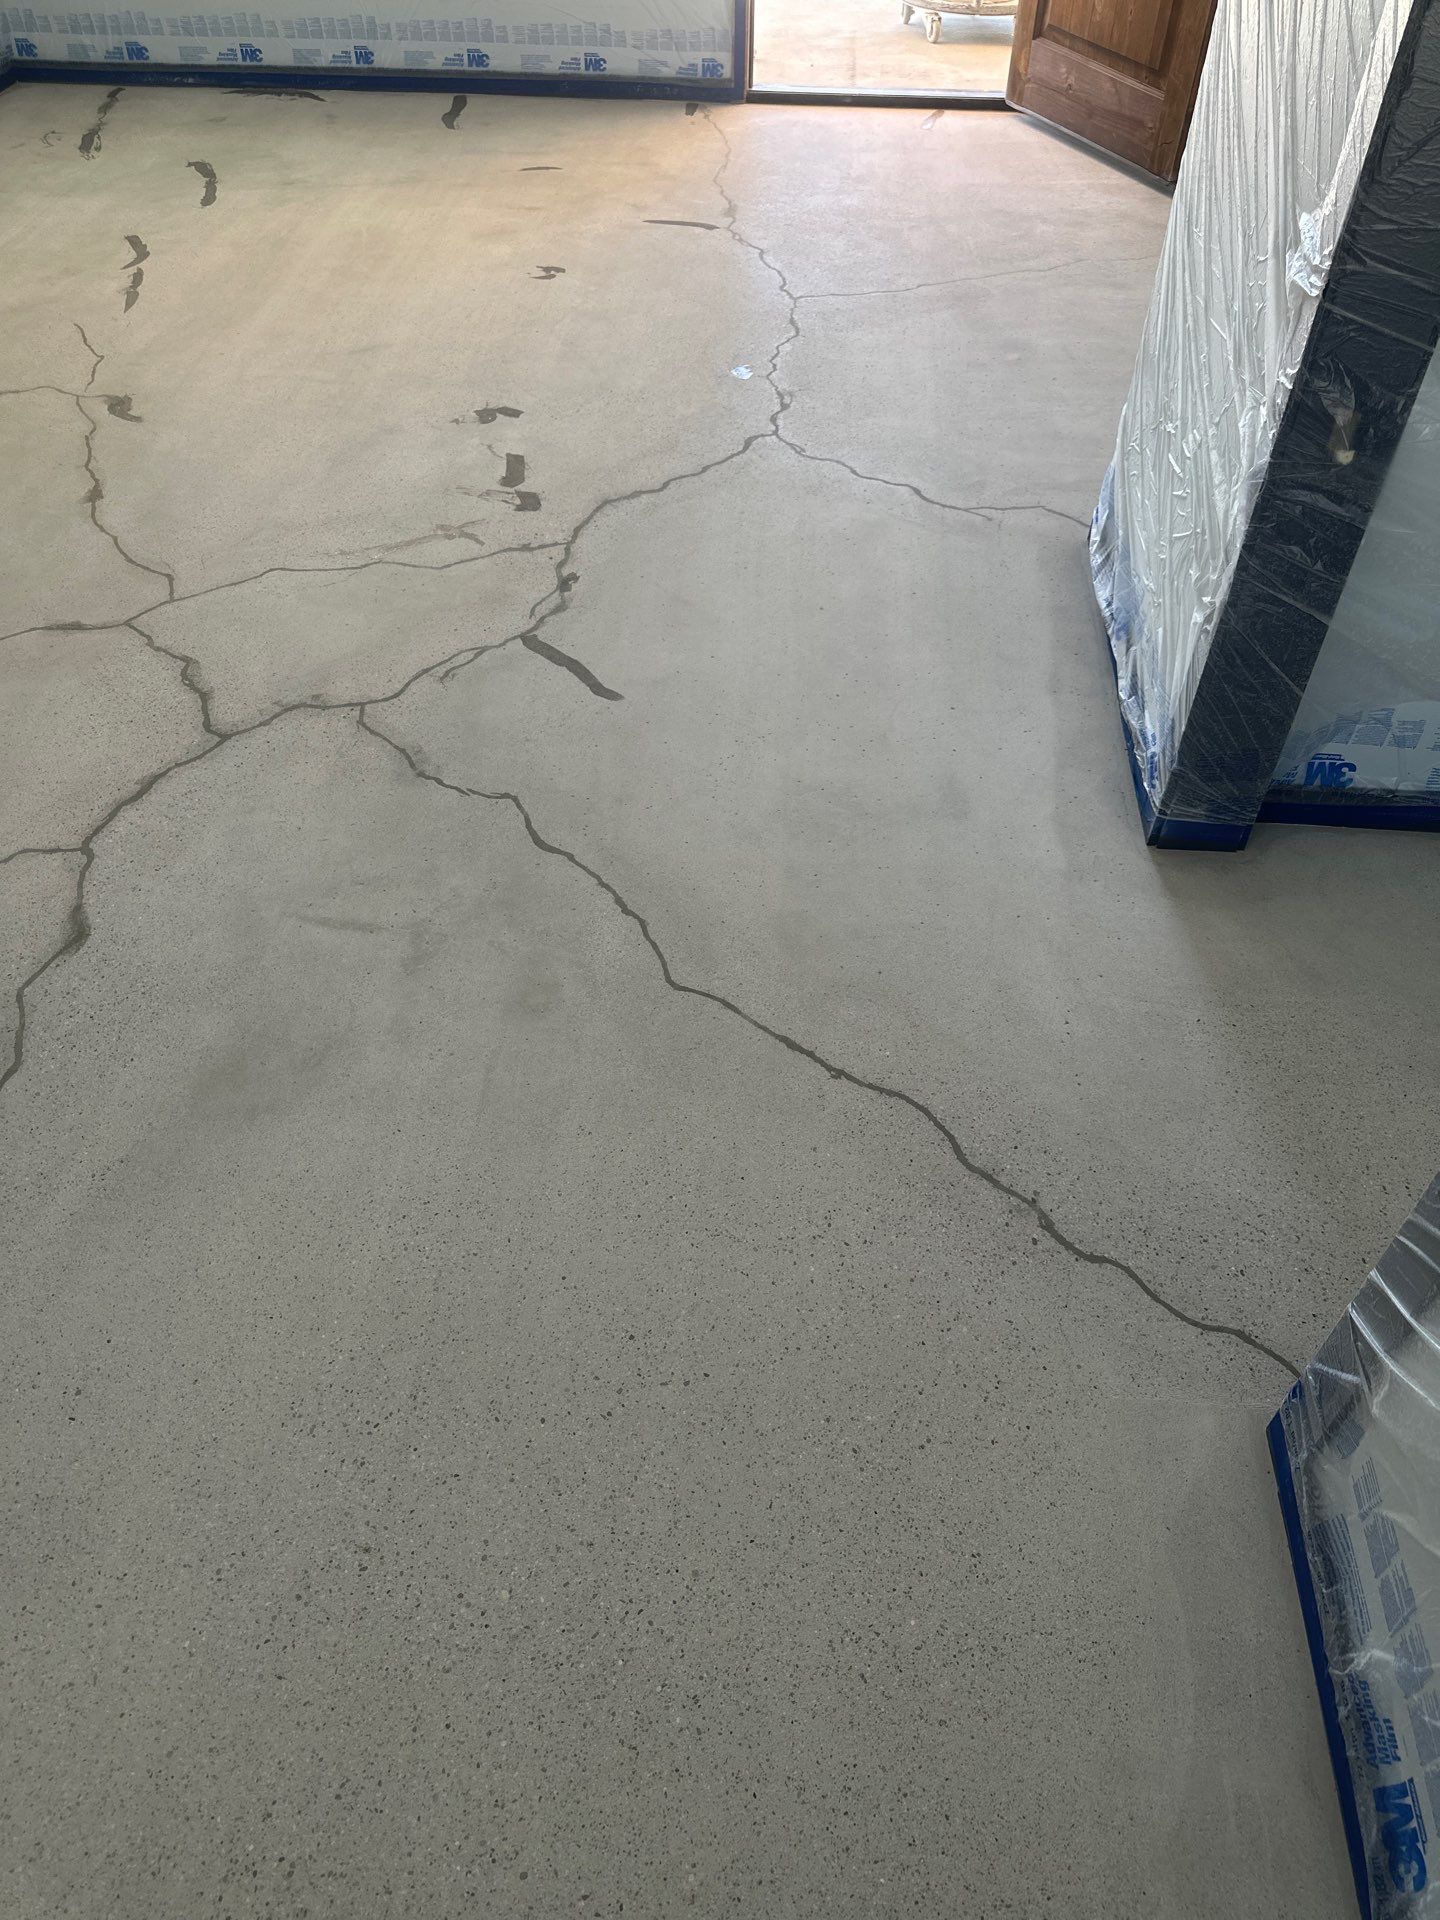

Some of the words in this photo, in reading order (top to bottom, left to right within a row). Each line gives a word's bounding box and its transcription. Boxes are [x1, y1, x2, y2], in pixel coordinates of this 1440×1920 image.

[15, 42, 38, 58] 3M
[126, 47, 149, 61] 3M
[240, 48, 263, 63] 3M
[355, 50, 375, 65] 3M
[467, 53, 490, 68] 3M
[584, 57, 607, 72] 3M
[702, 63, 724, 79] 3M
[1302, 762, 1357, 789] 3M
[1357, 1679, 1392, 1766] Masking
[1382, 1717, 1402, 1762] Film
[1372, 1780, 1427, 1894] 3M
